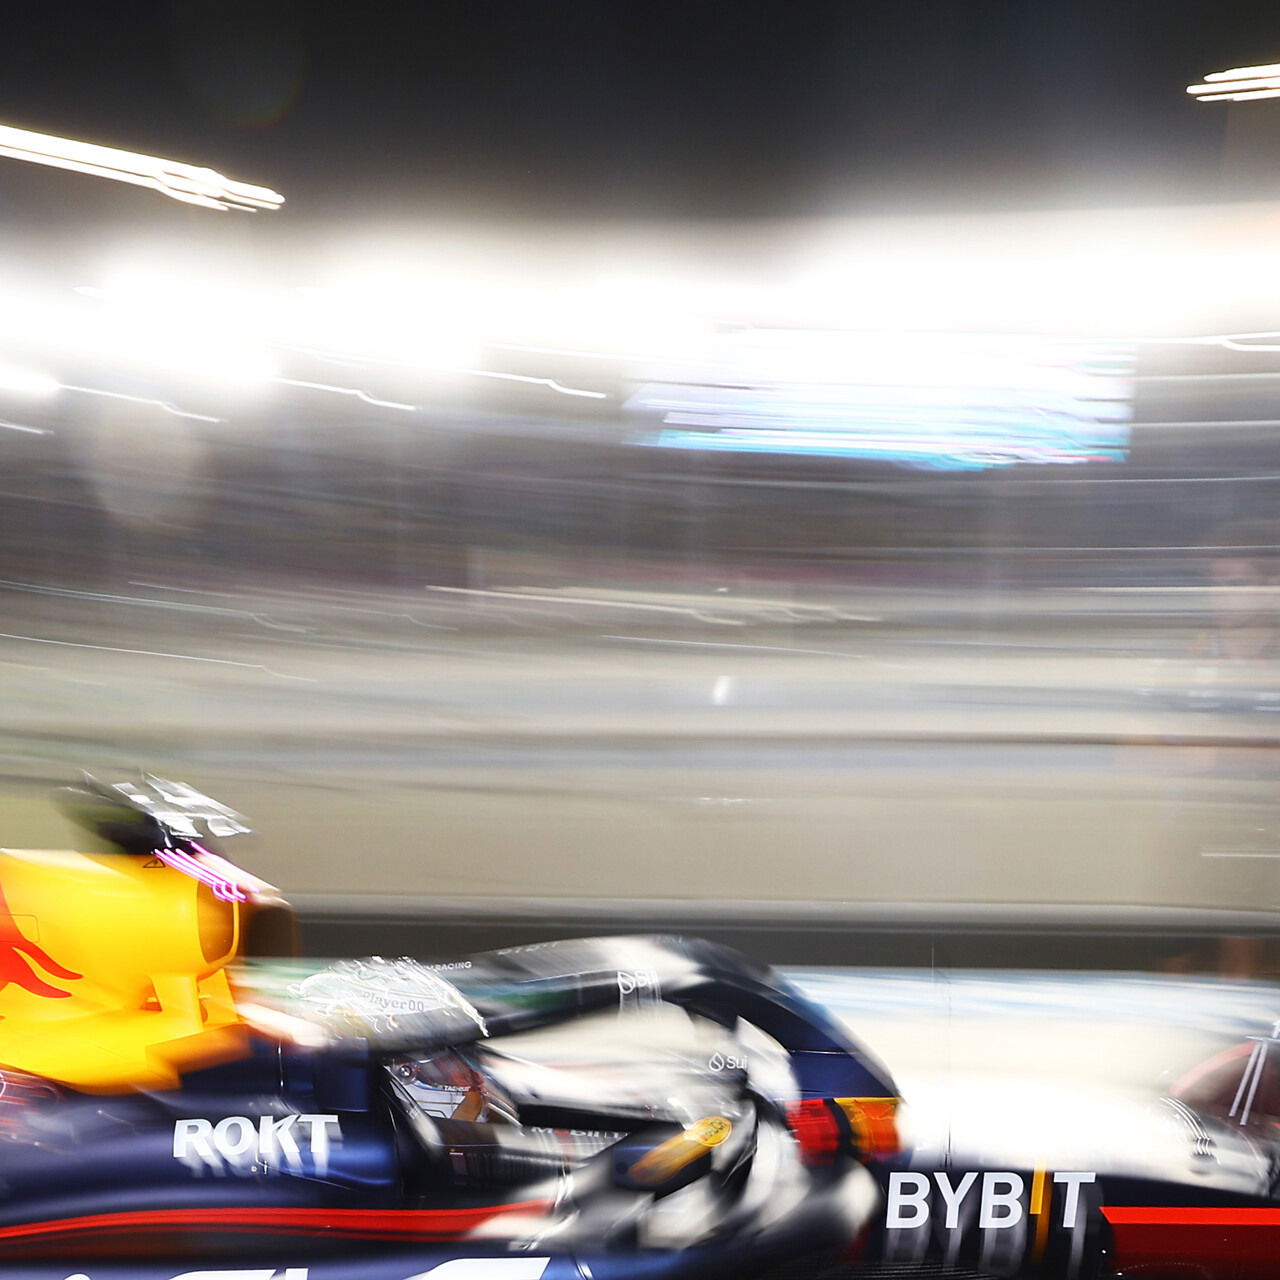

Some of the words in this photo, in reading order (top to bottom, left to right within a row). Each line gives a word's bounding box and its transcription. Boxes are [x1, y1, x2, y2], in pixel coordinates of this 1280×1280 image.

[726, 1055, 748, 1070] Sui
[173, 1114, 339, 1158] ROKT
[886, 1168, 1096, 1229] BYBIT
